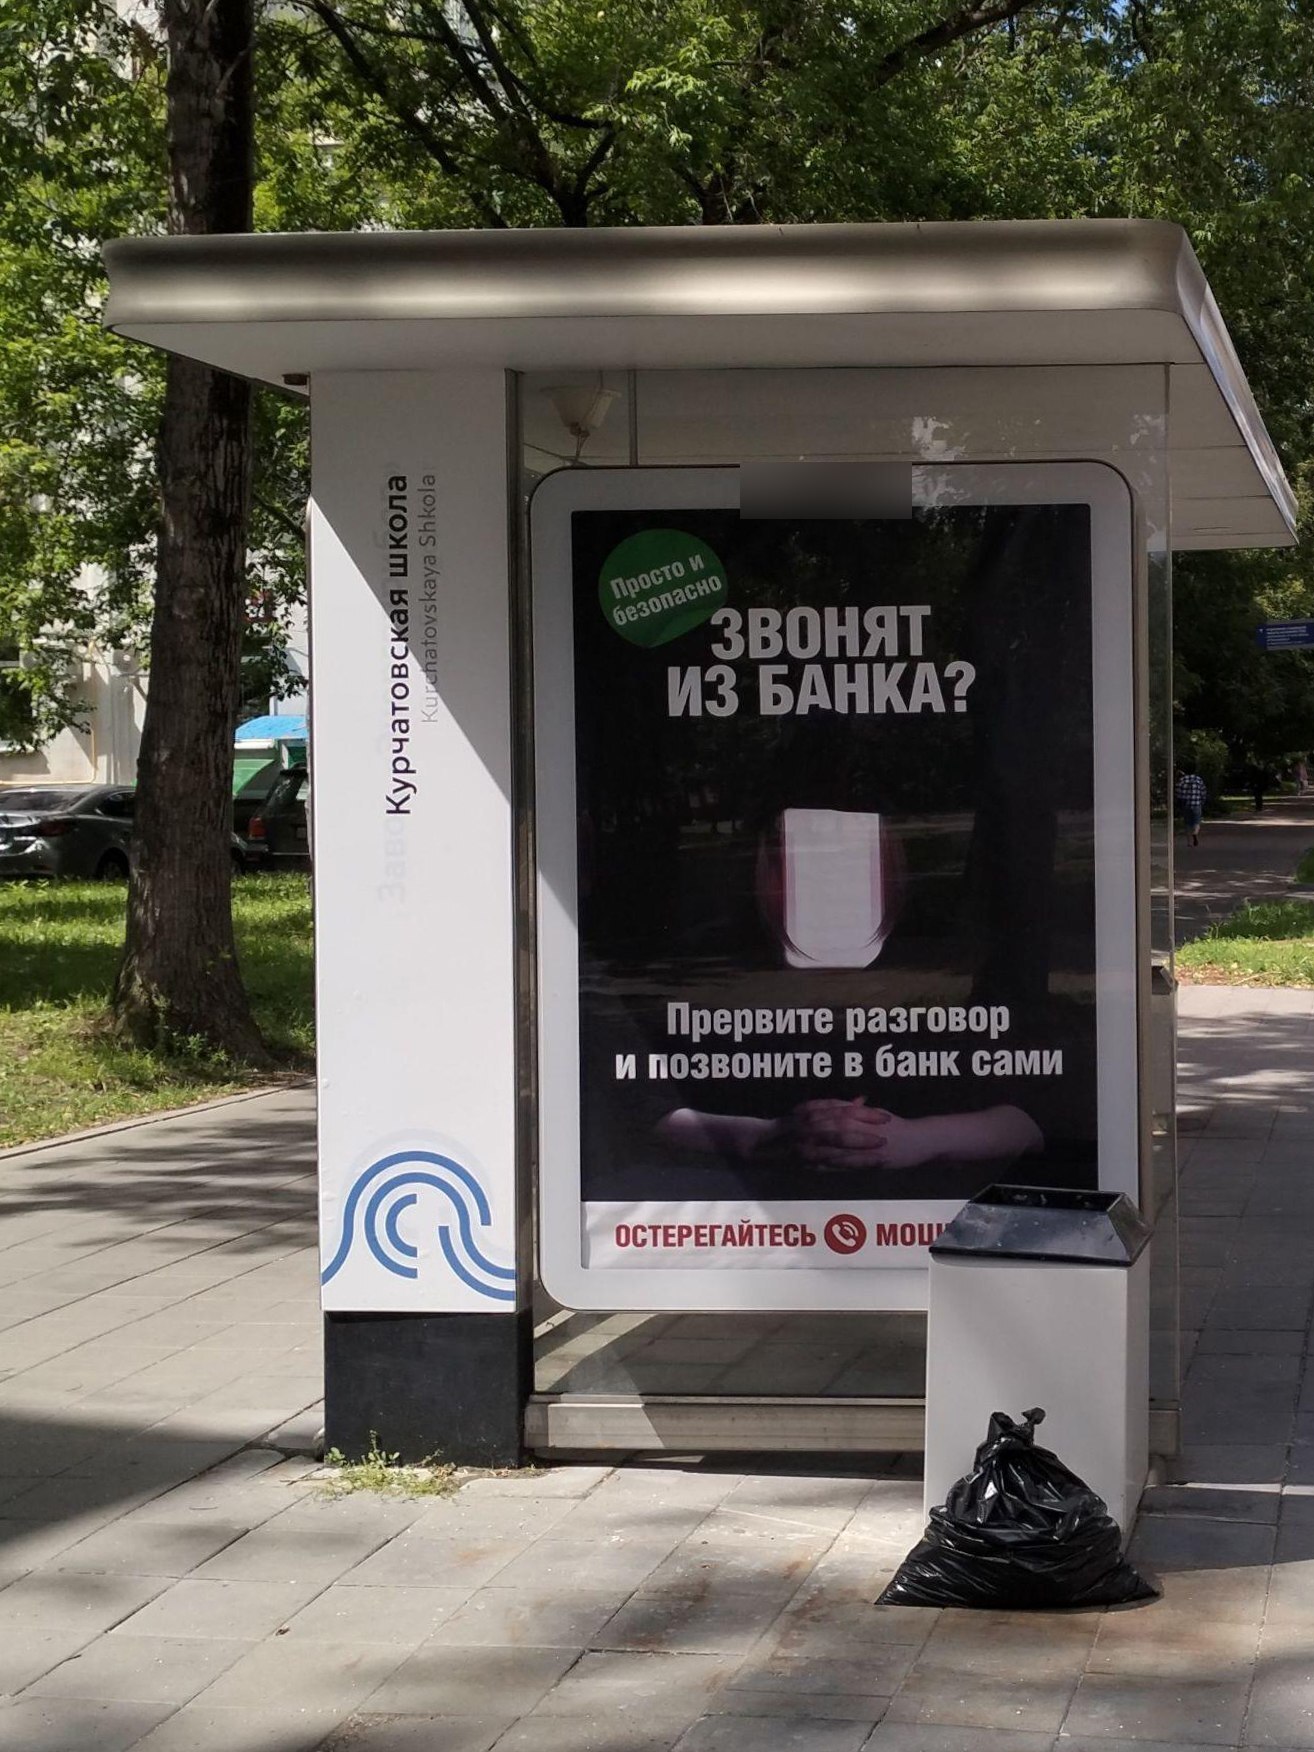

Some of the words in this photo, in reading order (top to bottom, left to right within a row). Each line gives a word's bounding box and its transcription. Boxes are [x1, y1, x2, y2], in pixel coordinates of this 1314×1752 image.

[388, 475, 408, 577] школа
[417, 474, 436, 547] Shkola
[610, 561, 685, 599] Просто
[688, 554, 705, 572] и
[612, 575, 722, 625] безопасно
[418, 555, 440, 723] Kurchatovskaya
[710, 605, 932, 660] ЗВОНЯТ
[384, 589, 417, 815] Курчатовская
[667, 665, 739, 718] ИЗ
[758, 660, 977, 716] БАНКА?
[667, 1002, 834, 1043] Прервите
[846, 1003, 1010, 1042] разговор
[615, 1053, 637, 1080] и
[648, 1050, 833, 1080] позвоните
[844, 1052, 864, 1078] в
[875, 1043, 961, 1078] банк
[971, 1048, 1064, 1077] сами
[614, 1219, 817, 1249] ОСТЕРЕГАЙТЕСЬ
[876, 1222, 949, 1247] МОШ
